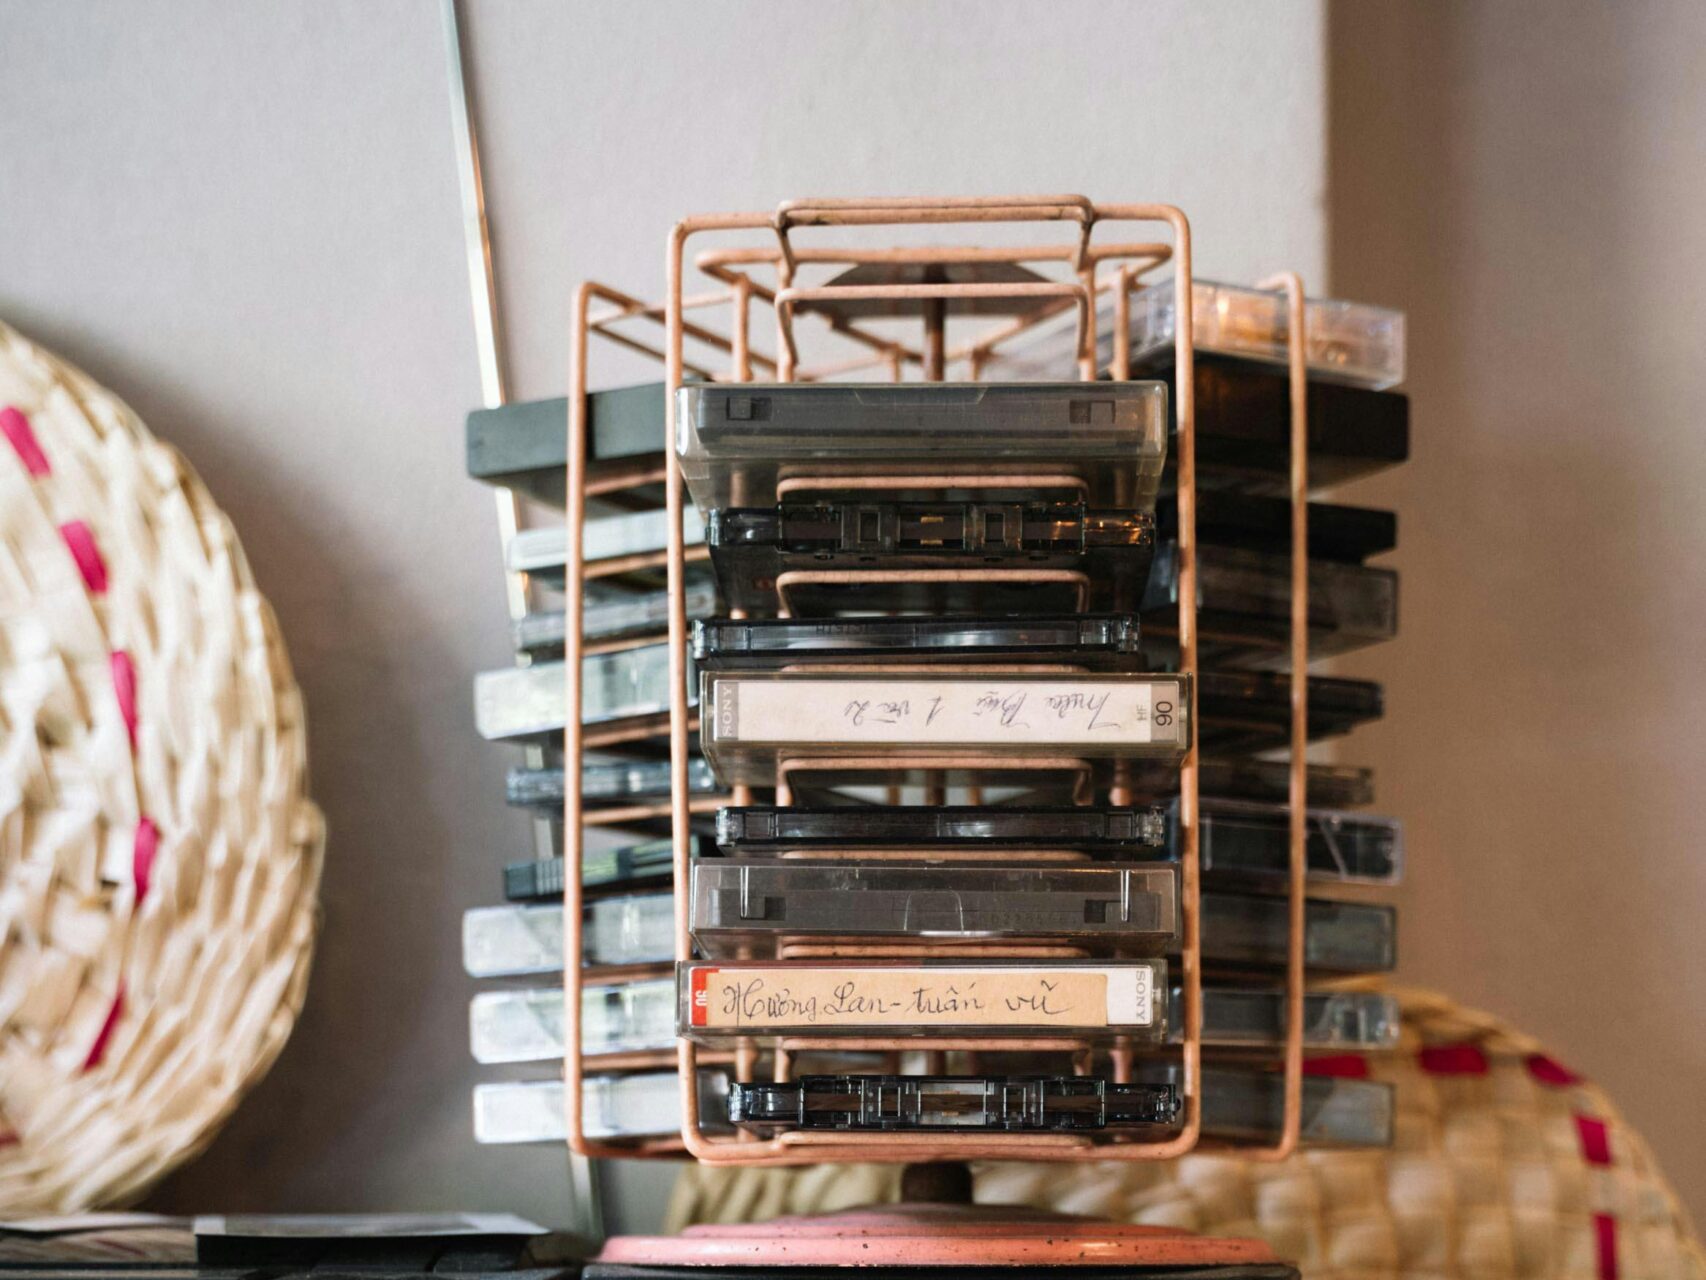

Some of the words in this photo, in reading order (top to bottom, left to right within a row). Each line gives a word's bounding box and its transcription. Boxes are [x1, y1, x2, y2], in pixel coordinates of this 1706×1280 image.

[722, 686, 732, 737] SONY
[1155, 700, 1174, 727] 90
[1135, 969, 1147, 1021] SONY
